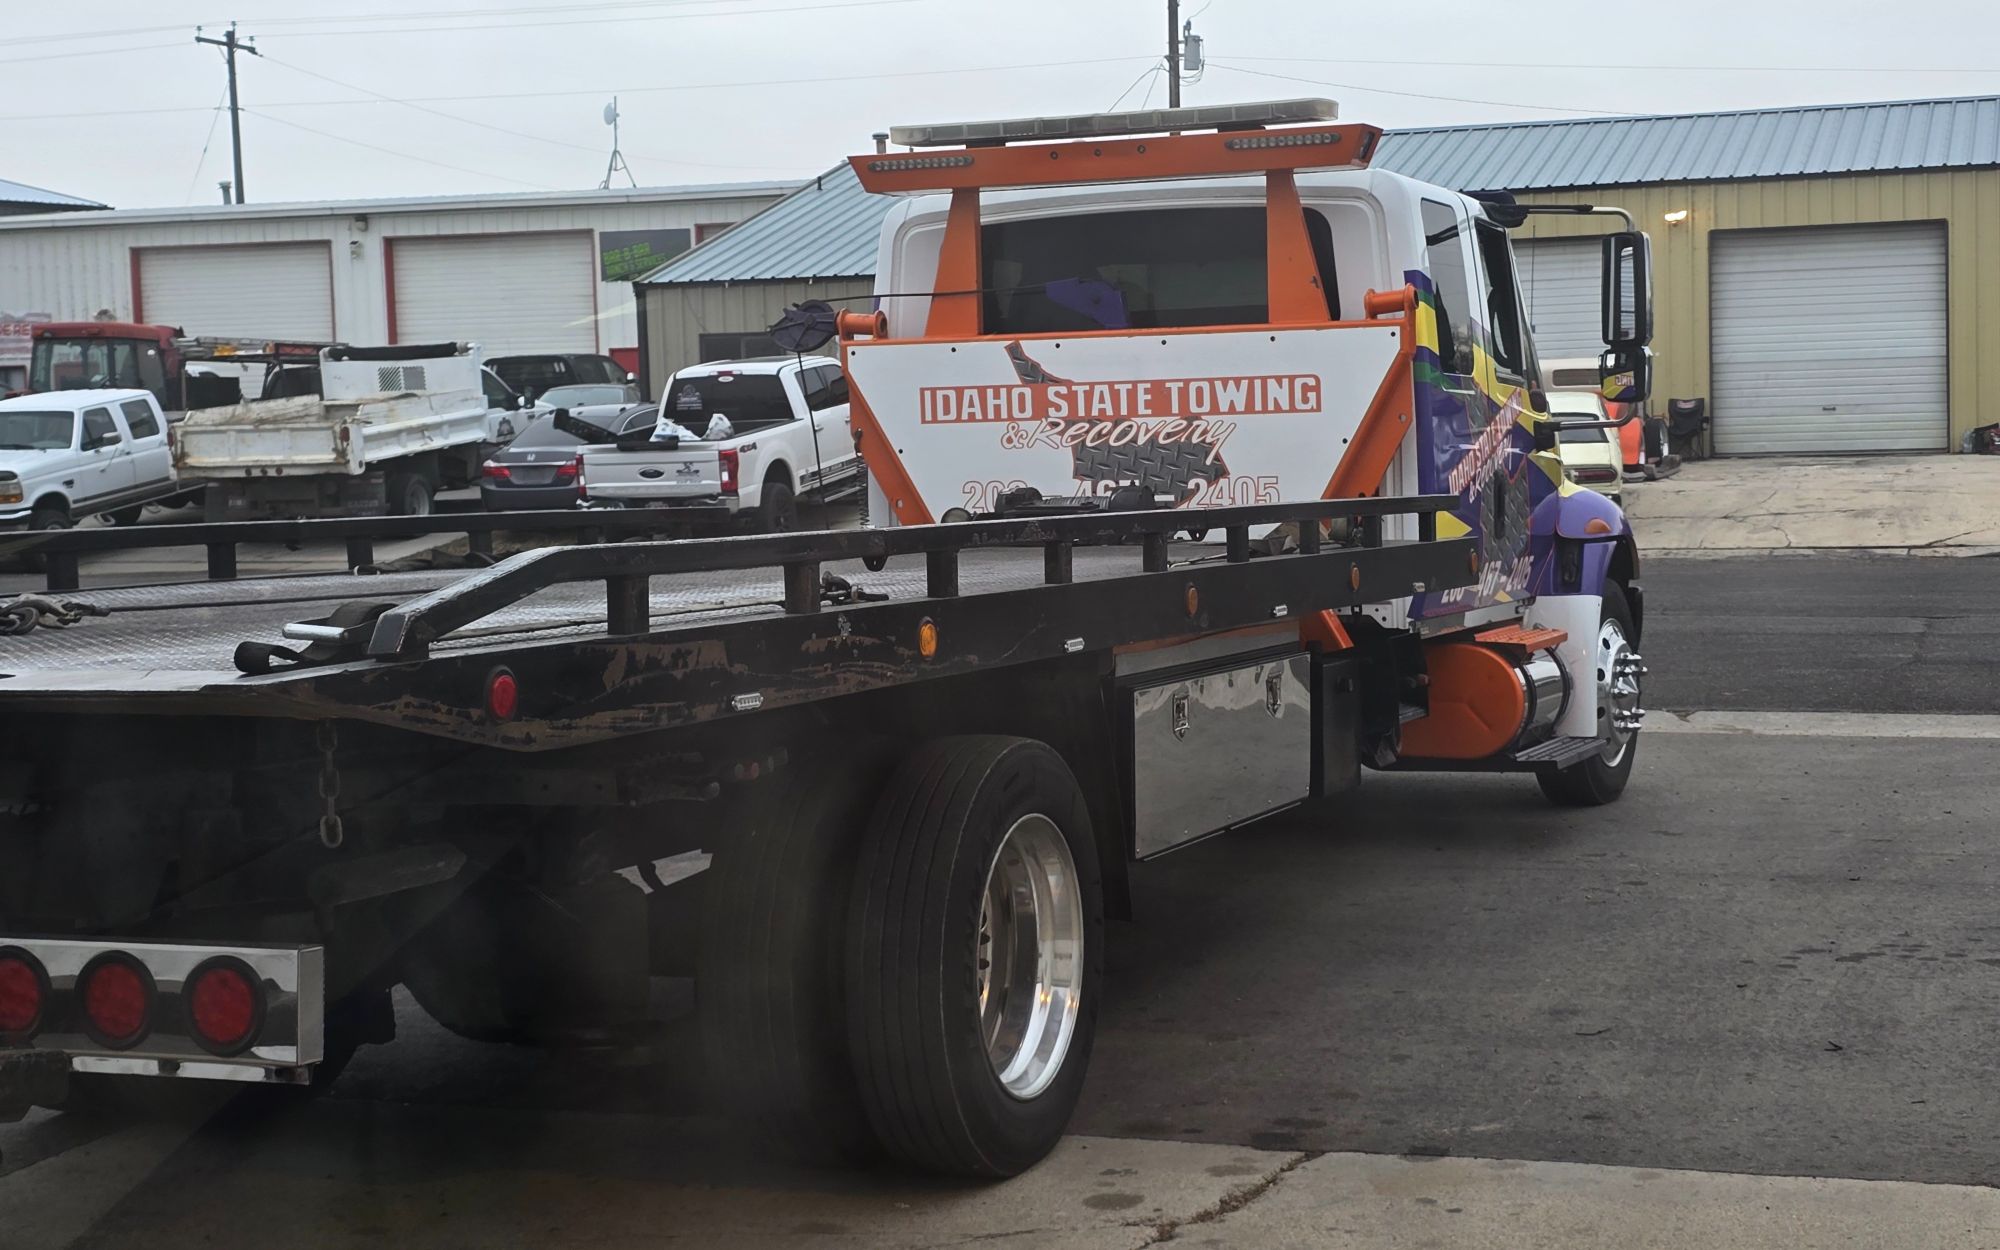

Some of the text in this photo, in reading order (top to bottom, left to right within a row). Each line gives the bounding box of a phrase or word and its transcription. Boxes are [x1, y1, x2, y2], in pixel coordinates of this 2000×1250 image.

[924, 377, 1316, 421] IDAHO STATE TOWING
[1186, 476, 1280, 508] 2405
[1448, 449, 1477, 496] IDAHO
